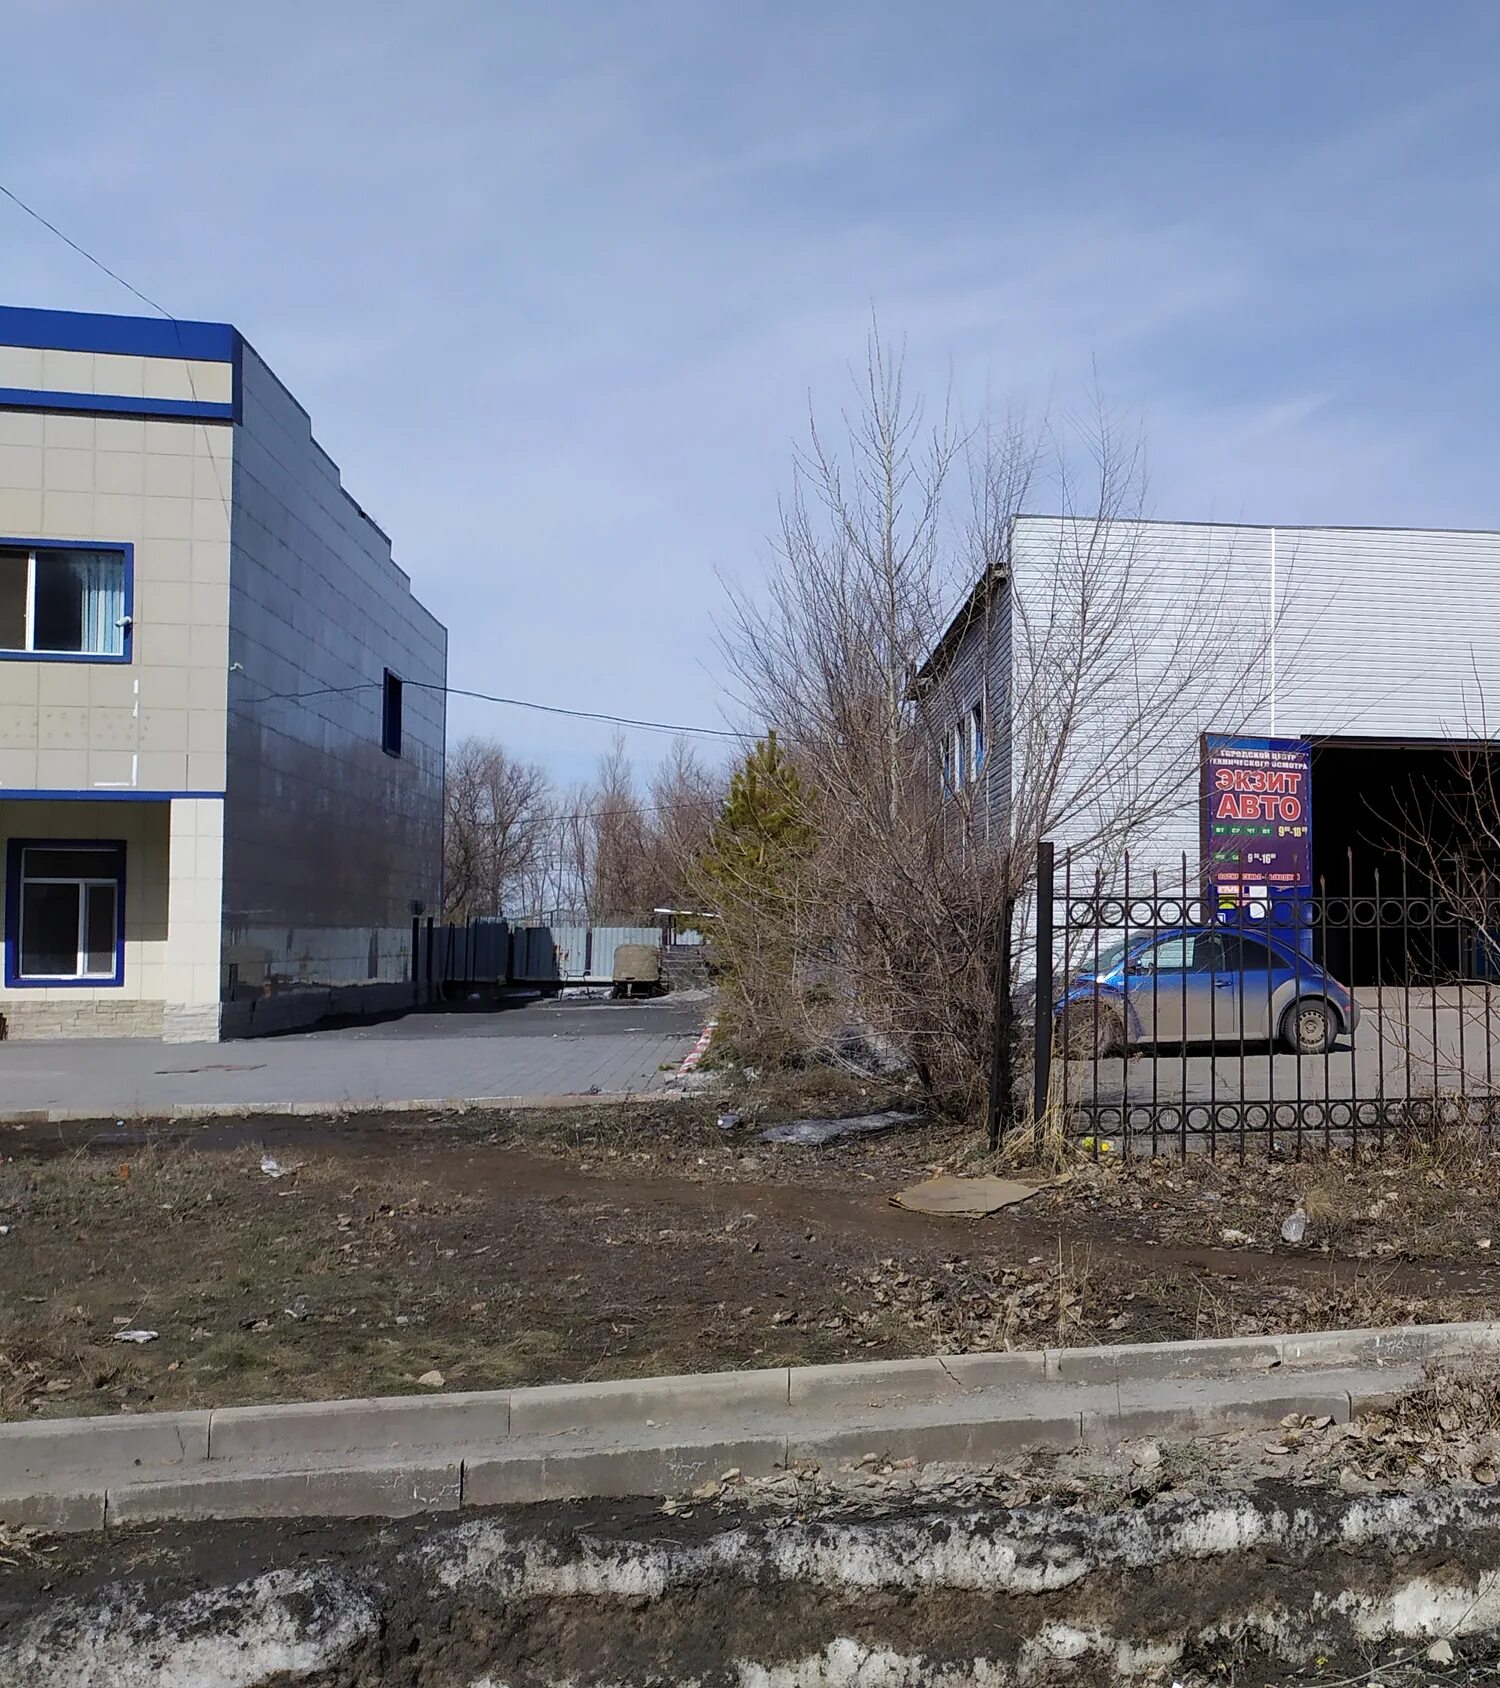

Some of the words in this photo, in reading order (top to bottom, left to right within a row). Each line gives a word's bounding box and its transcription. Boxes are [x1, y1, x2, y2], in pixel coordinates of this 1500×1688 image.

[1220, 750, 1270, 760] ГОРОДСКОЙ
[1271, 761, 1309, 770] ОСМОТРА
[1215, 768, 1301, 794] ЭКЗИТ
[1216, 793, 1301, 821] АВТО
